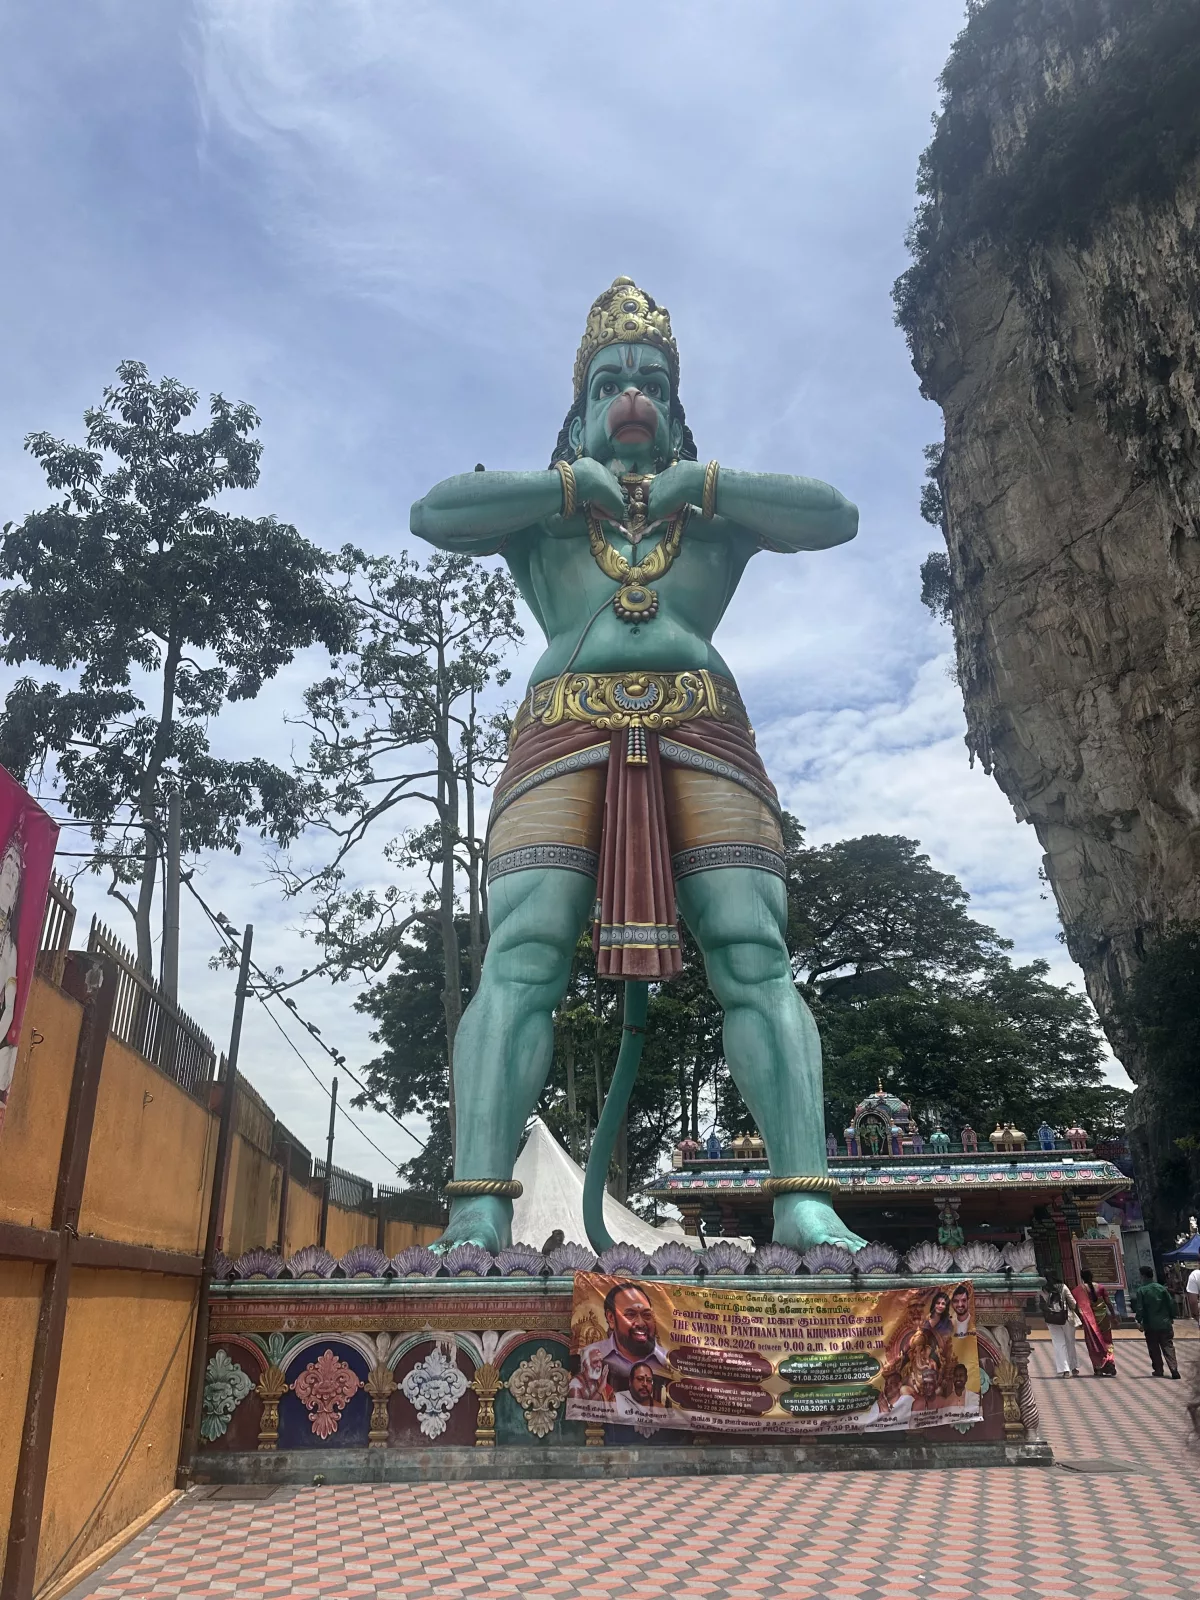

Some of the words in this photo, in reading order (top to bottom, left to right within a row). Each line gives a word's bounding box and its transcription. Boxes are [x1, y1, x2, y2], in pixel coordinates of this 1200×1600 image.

[765, 1304, 777, 1315] ஸ்ரீ
[779, 1306, 814, 1314] கணேசர்
[816, 1306, 850, 1314] கோயில்
[723, 1313, 764, 1325] பந்தன
[672, 1320, 688, 1330] THE
[692, 1322, 727, 1335] SWARNA
[731, 1326, 777, 1338] PANTHANA
[780, 1328, 804, 1338] MAHA
[807, 1326, 884, 1338] KHUMBABISHEGAM
[670, 1332, 702, 1345] Sunday
[704, 1336, 756, 1349] 23.08.2026
[784, 1341, 804, 1352] 9.00
[807, 1342, 827, 1352] a.m.
[830, 1342, 838, 1351] to
[842, 1340, 864, 1350] 10.40
[866, 1340, 886, 1349] a.m.
